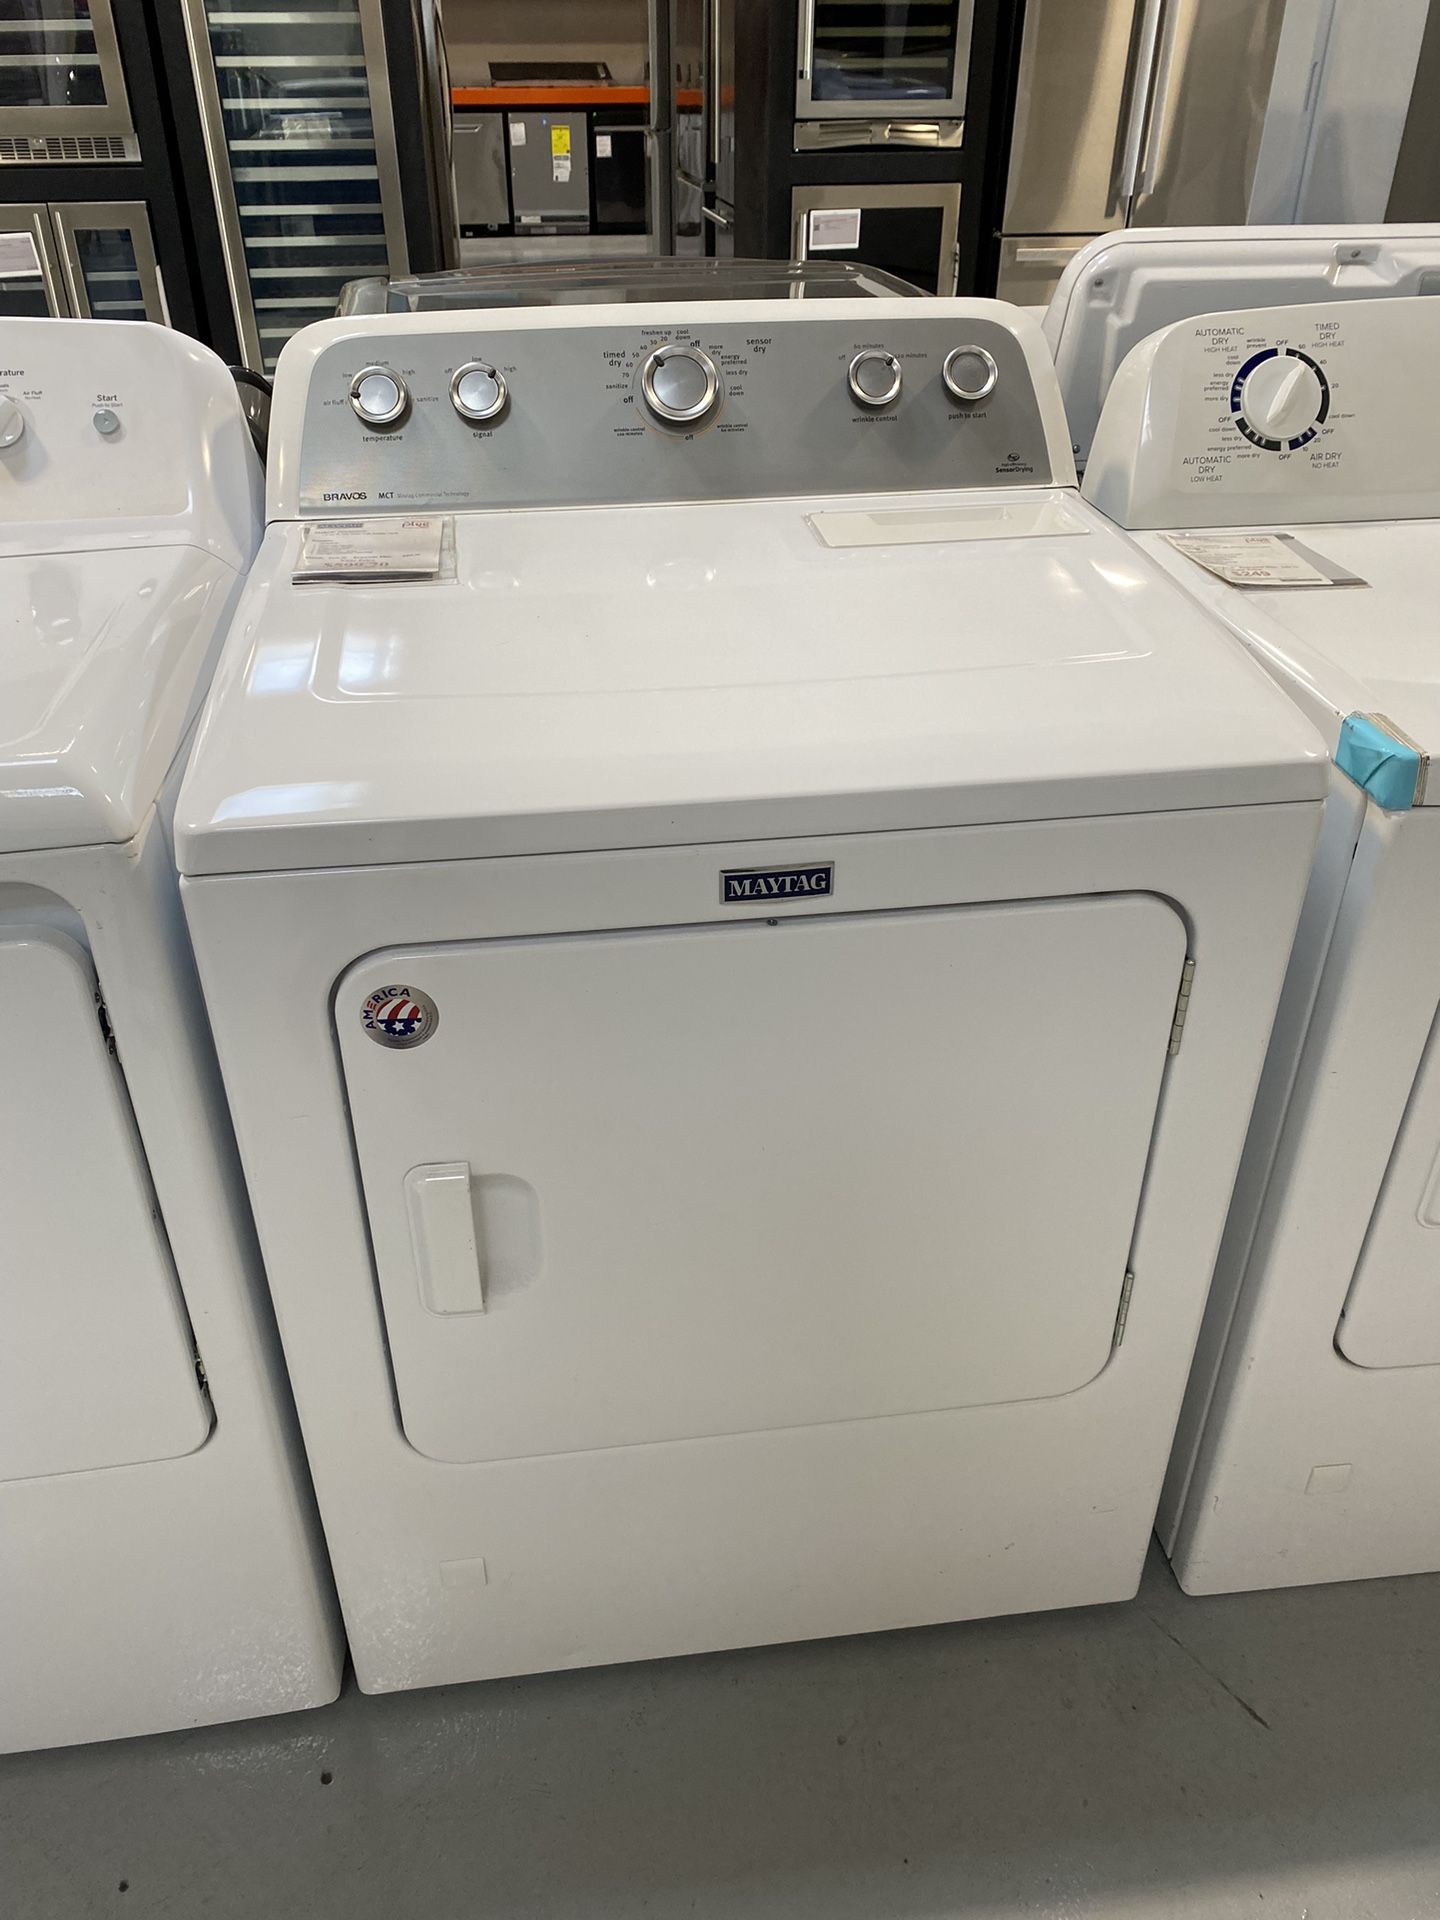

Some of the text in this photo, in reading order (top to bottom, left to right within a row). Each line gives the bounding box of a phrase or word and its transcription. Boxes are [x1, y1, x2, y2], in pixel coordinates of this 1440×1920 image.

[1315, 322, 1340, 331] TIMED
[1195, 328, 1244, 336] AUTOMATIC
[1319, 332, 1336, 340] DRY
[753, 345, 766, 354] dry
[603, 350, 626, 359] timed
[609, 359, 622, 368] dry
[97, 394, 118, 402] Start
[623, 396, 634, 404] off
[948, 412, 963, 420] push
[362, 434, 403, 443] temperature
[473, 431, 493, 440] signal
[1183, 456, 1232, 464] AUTOMATIC
[1325, 452, 1342, 460] DRY
[1198, 466, 1216, 474] DRY
[323, 491, 394, 501] BRAVOS MCT
[728, 873, 827, 897] MAYTAG
[362, 988, 411, 1030] AMERICA
